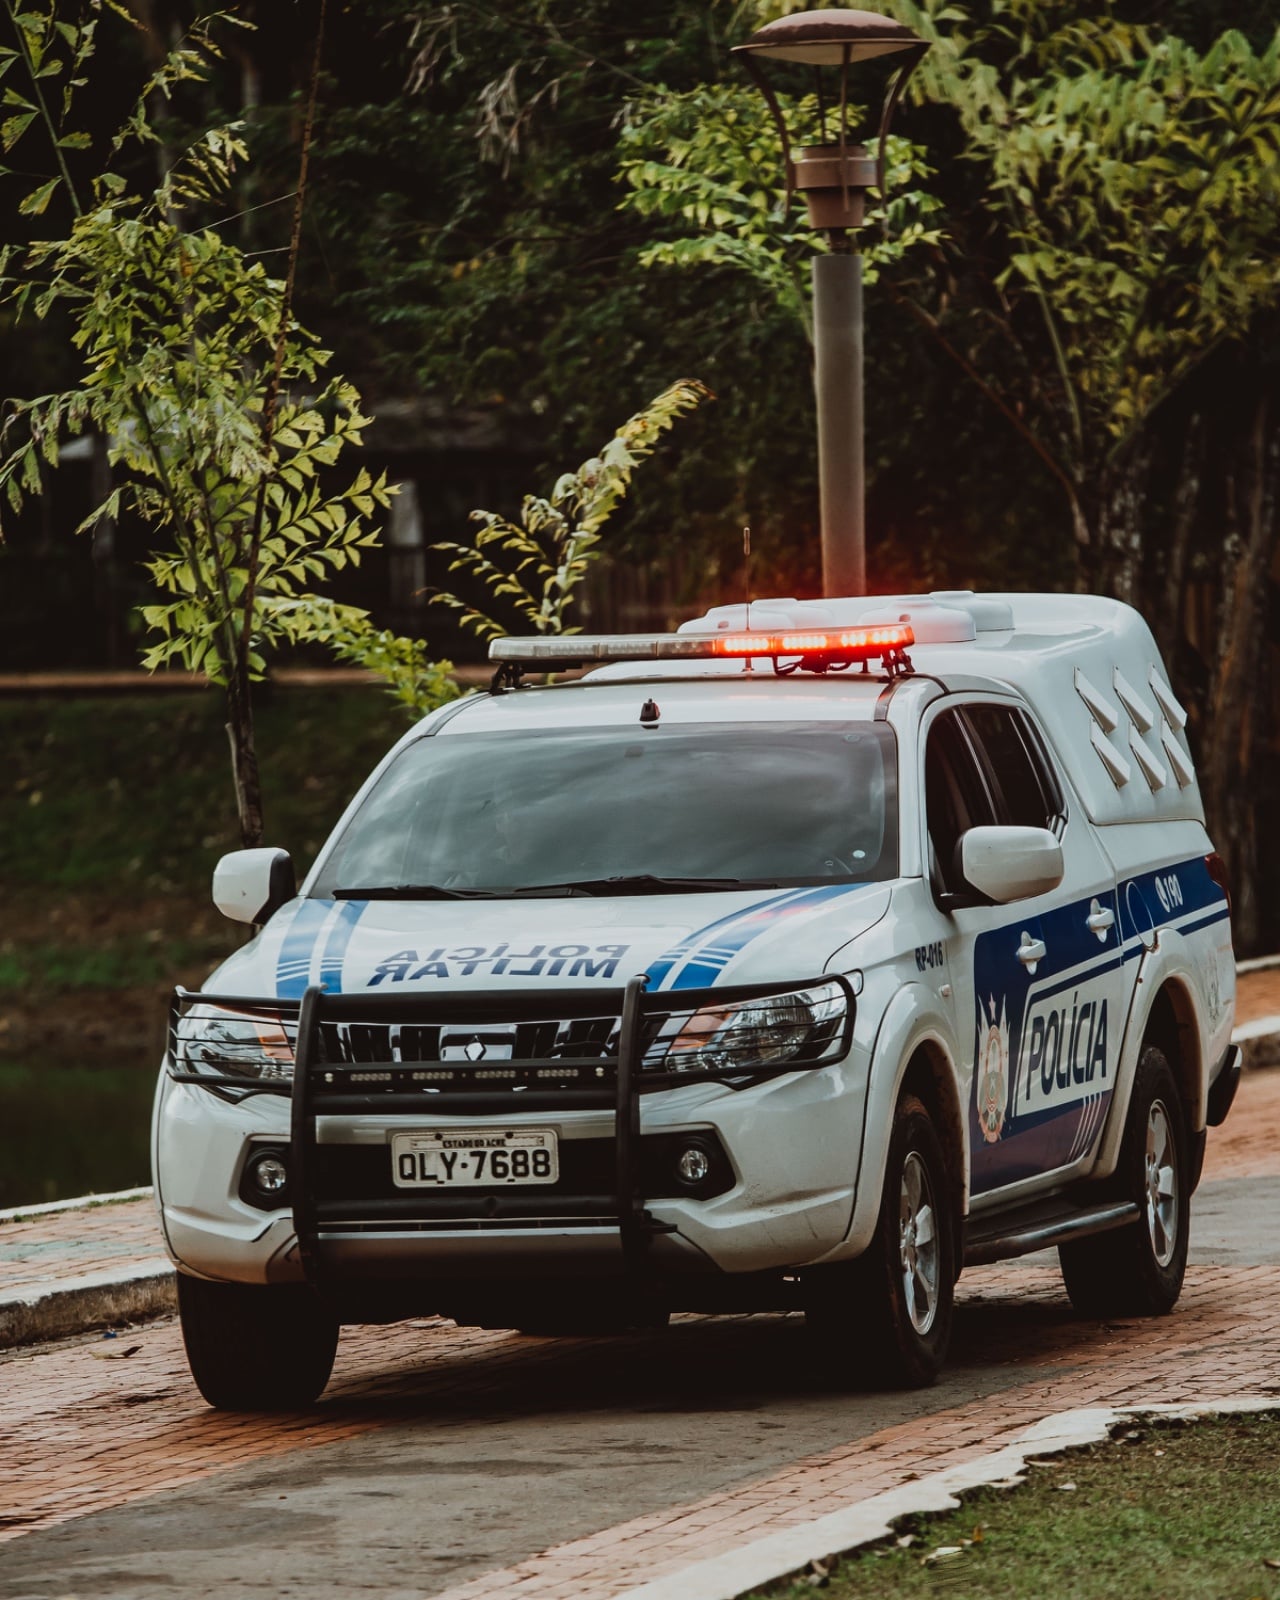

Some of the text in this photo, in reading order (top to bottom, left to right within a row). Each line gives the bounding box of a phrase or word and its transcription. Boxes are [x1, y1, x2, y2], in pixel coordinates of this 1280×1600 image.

[1163, 874, 1184, 909] 190
[914, 941, 944, 973] RP-016
[1026, 991, 1108, 1101] POLÍCIA
[486, 1138, 507, 1147] ACRE
